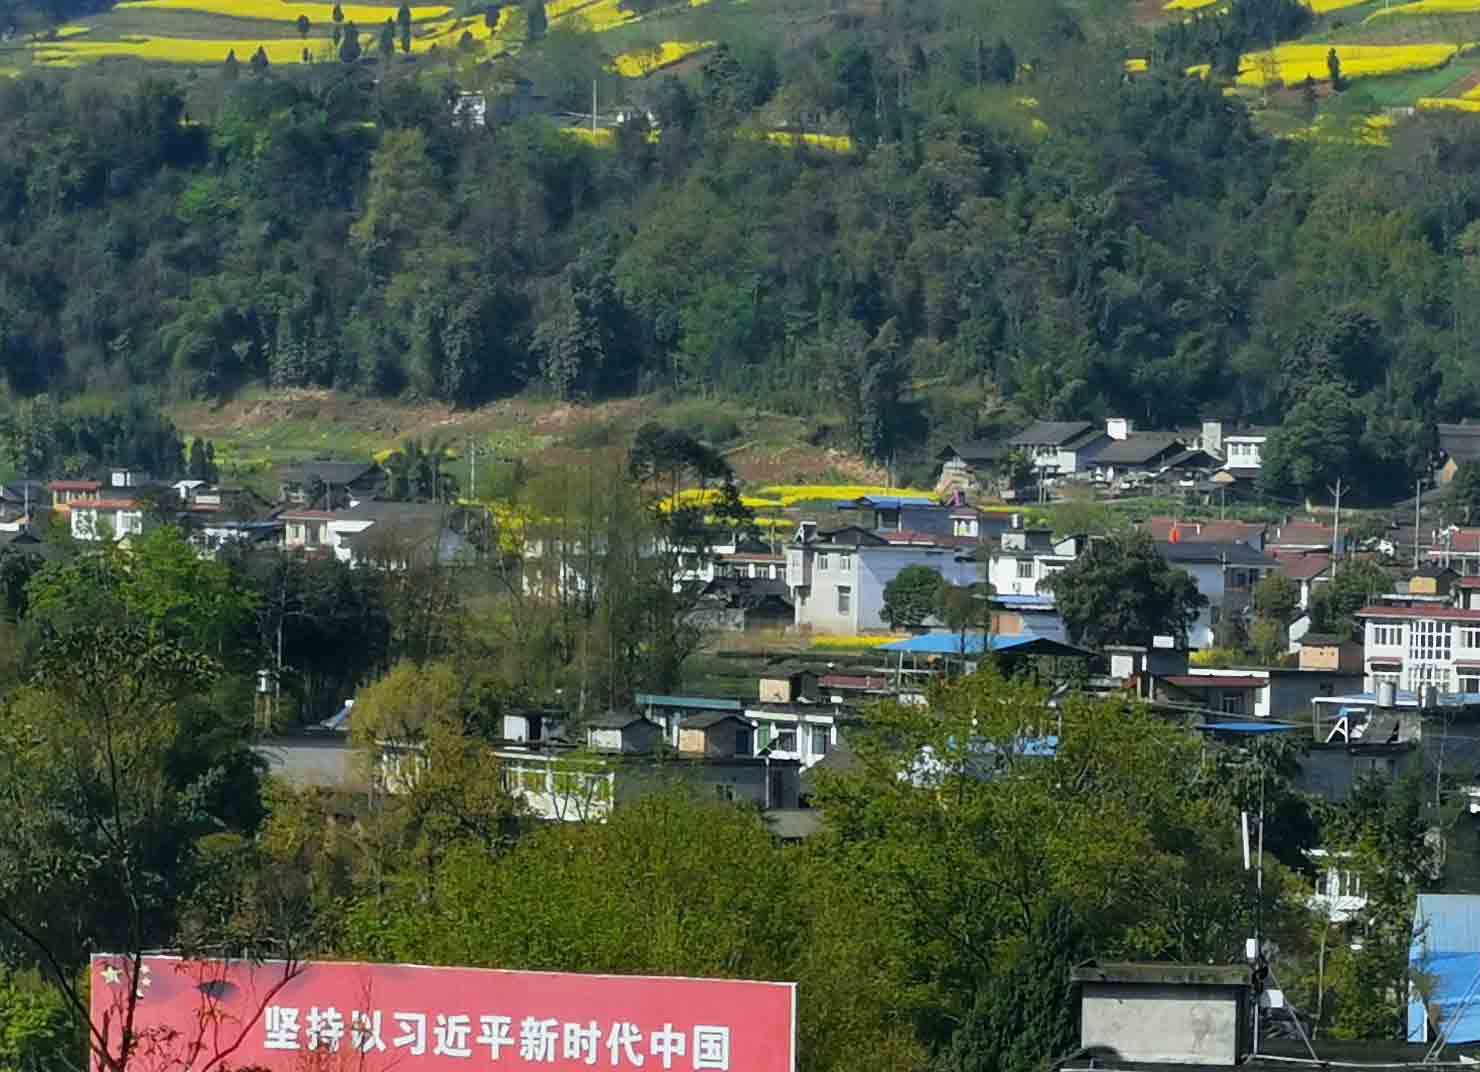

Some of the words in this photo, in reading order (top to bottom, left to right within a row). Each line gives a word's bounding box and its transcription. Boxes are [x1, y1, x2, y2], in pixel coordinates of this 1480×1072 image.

[263, 1004, 731, 1071] 坚持以习近平新时代中国
